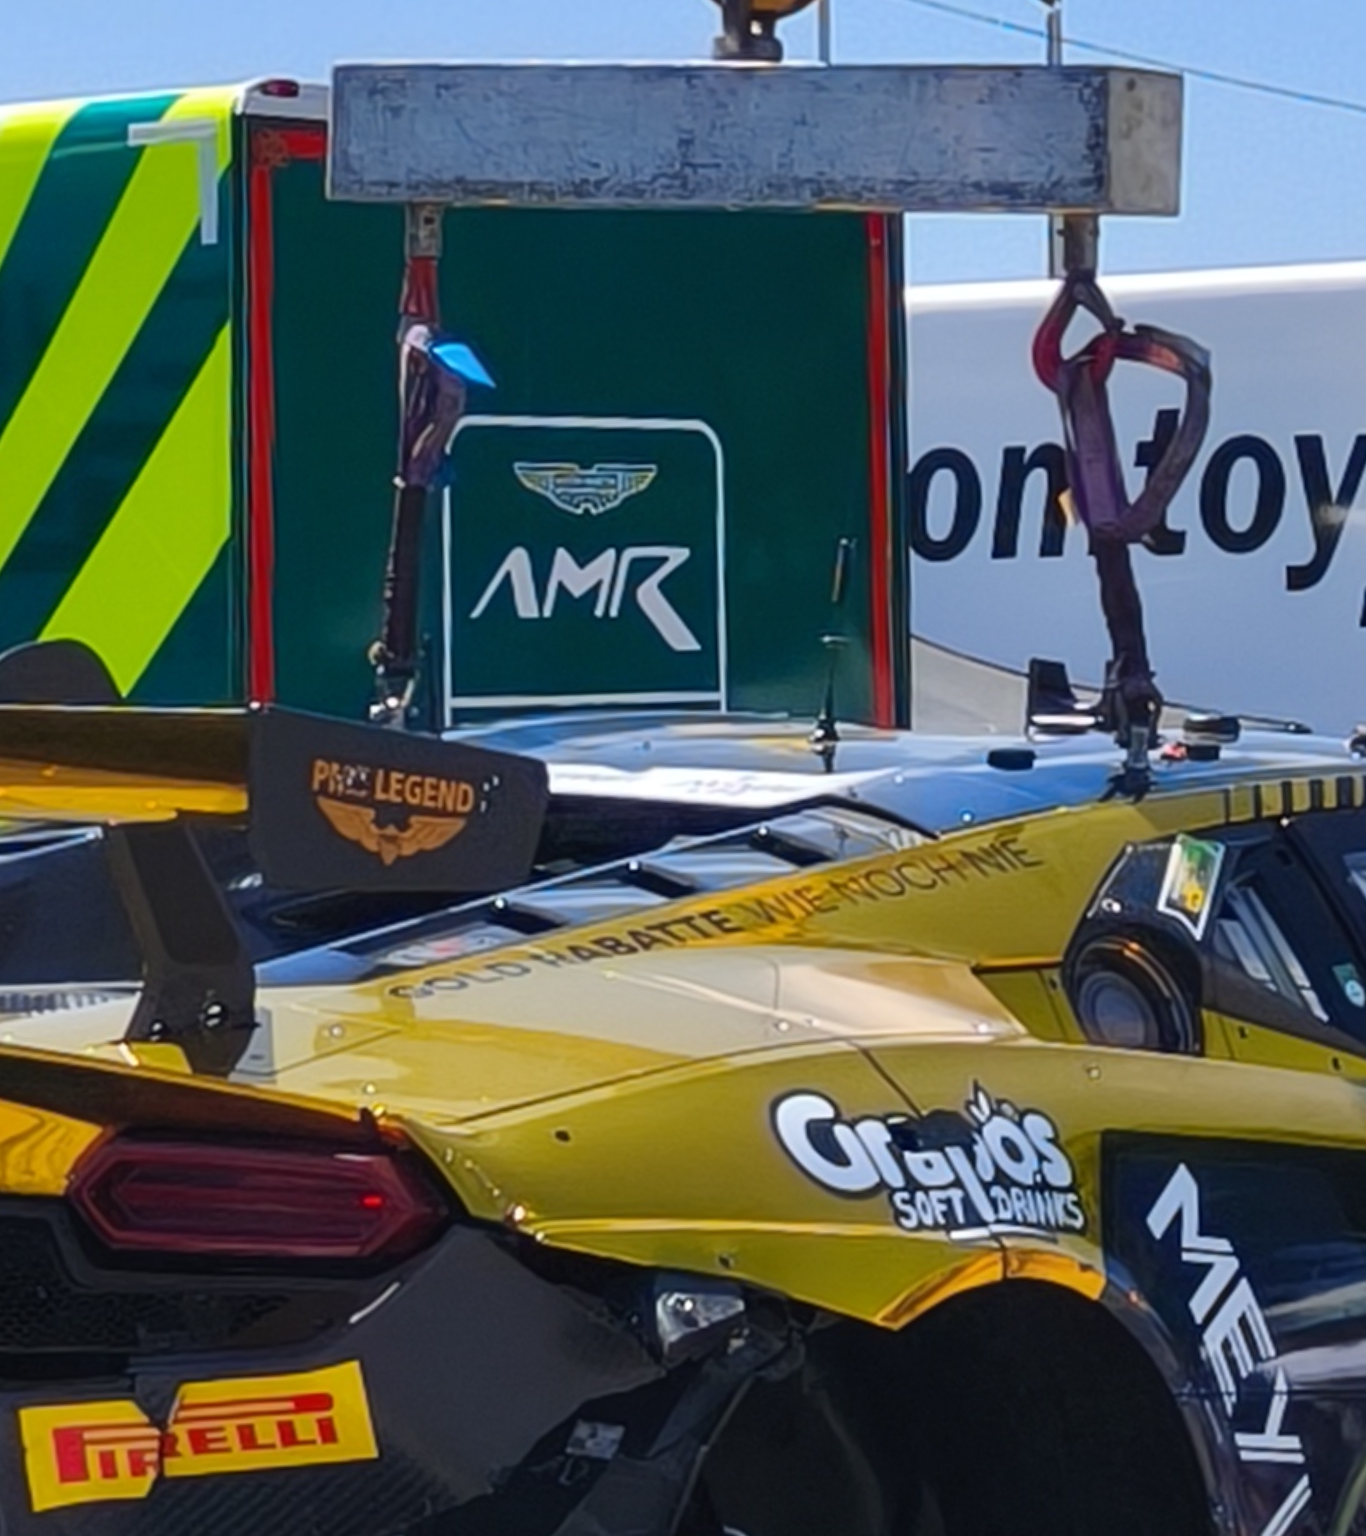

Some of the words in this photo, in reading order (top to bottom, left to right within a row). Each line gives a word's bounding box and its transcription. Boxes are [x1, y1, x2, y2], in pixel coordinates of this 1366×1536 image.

[470, 546, 702, 651] AMR
[374, 768, 475, 814] LEGEND
[389, 959, 532, 1000] GOLD
[530, 909, 749, 969] RABATTE
[740, 885, 840, 928] WIE
[830, 852, 969, 907] NOCH
[961, 836, 1044, 879] NIE
[892, 1186, 965, 1229] SOFT
[990, 1187, 1085, 1229] DRINKS
[52, 1392, 339, 1485] PIRELLI
